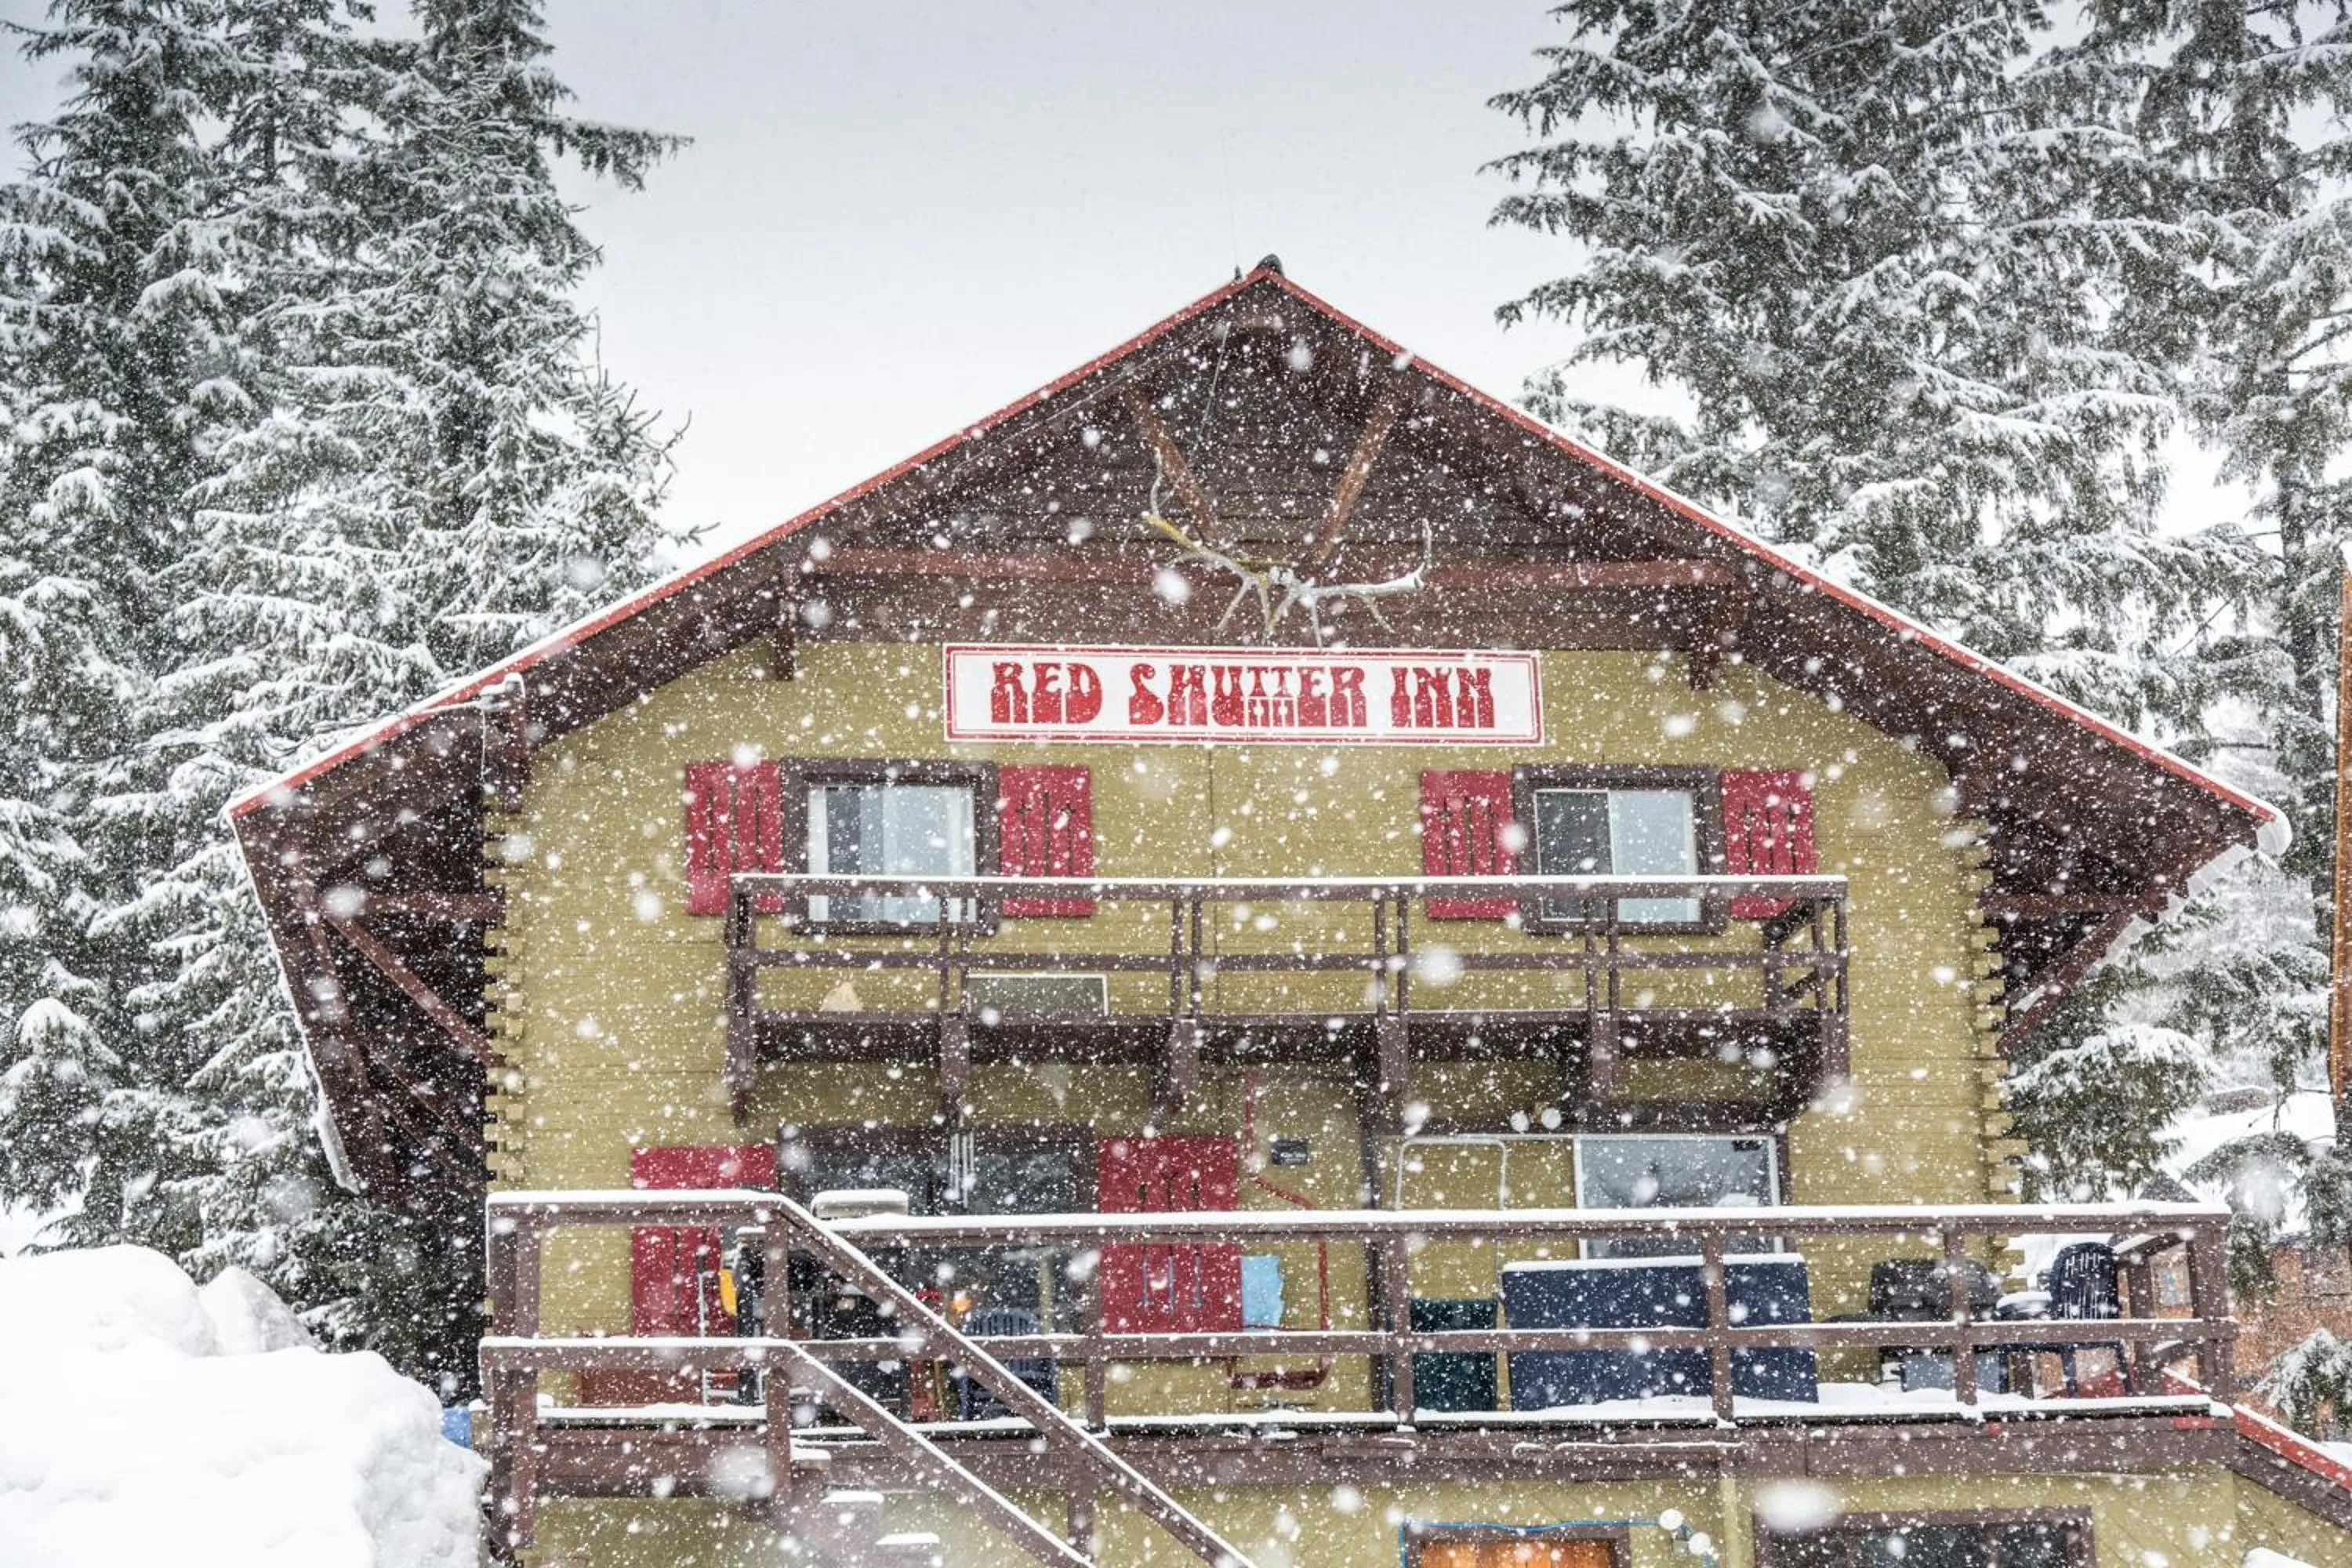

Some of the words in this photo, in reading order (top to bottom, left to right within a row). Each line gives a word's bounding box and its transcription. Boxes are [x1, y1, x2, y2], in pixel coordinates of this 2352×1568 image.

[990, 662, 1103, 724] RED
[1128, 664, 1367, 728] SHUTTER
[1390, 667, 1495, 728] INN
